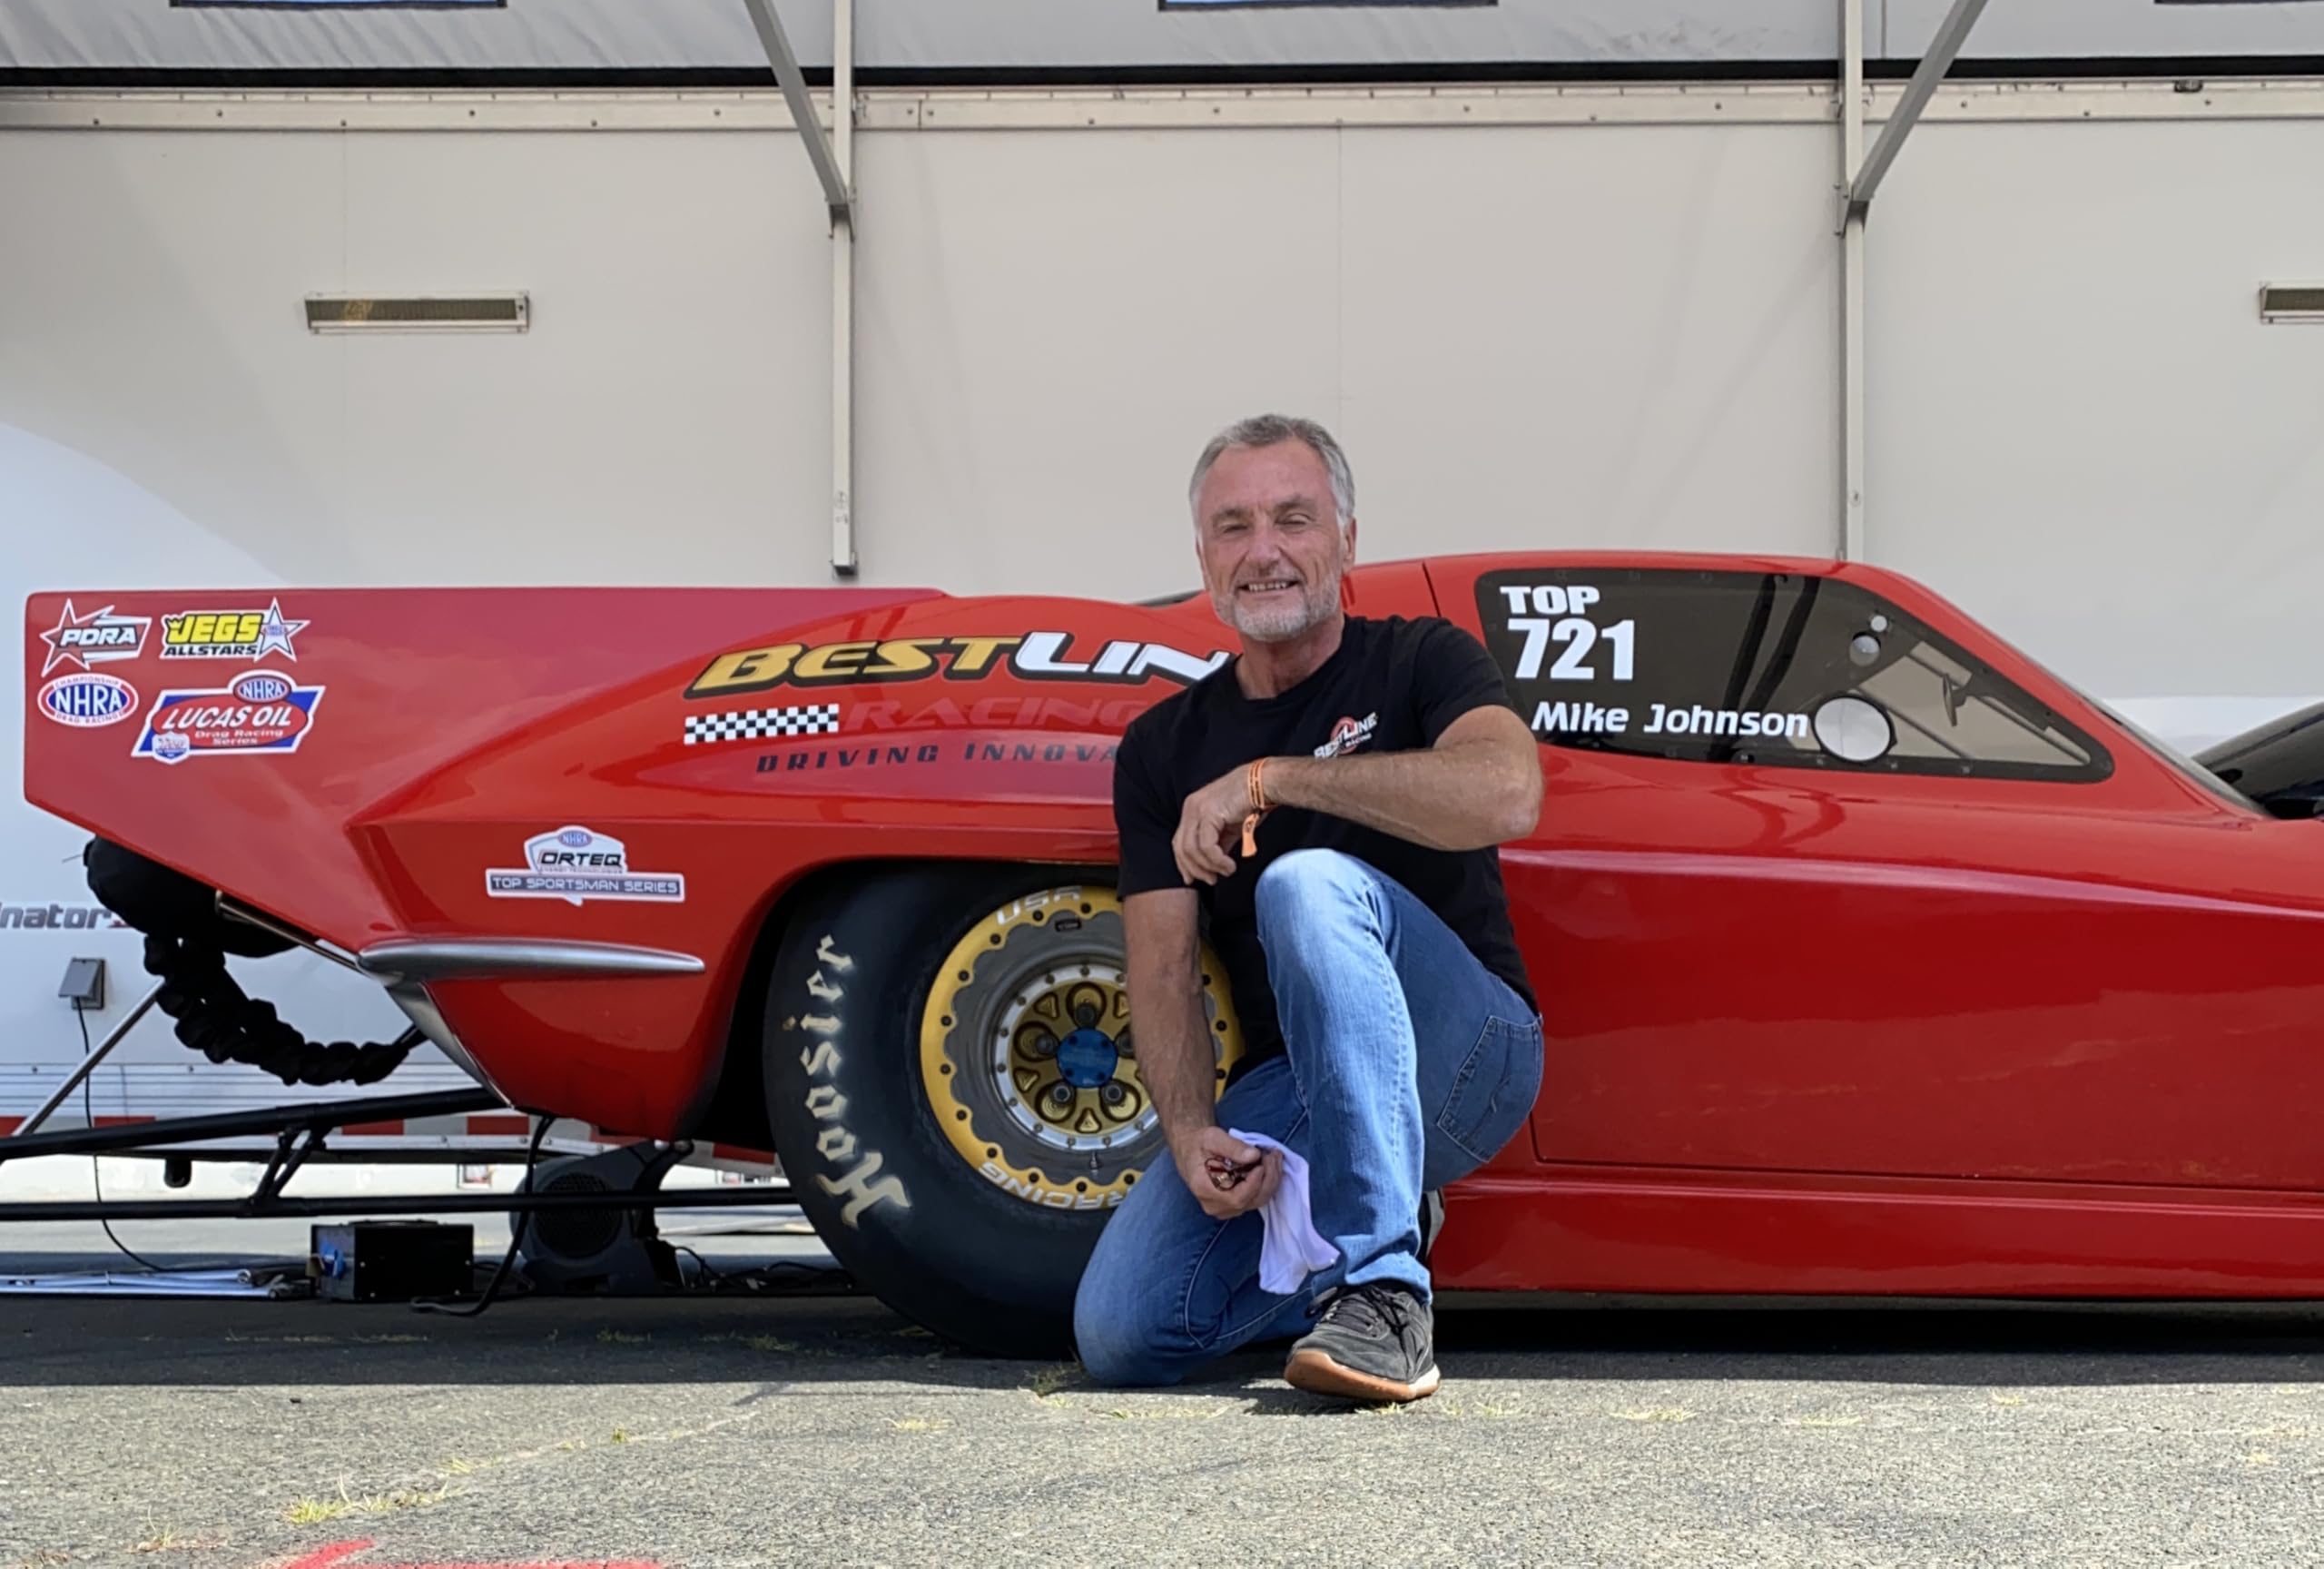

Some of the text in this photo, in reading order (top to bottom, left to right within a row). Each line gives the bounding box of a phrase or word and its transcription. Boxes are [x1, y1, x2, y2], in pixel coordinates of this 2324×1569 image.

[1500, 586, 1600, 615] TOP
[59, 627, 137, 646] PDRA
[167, 614, 263, 644] JEGS
[163, 645, 257, 656] ALLSTARS
[1507, 618, 1634, 681] 721
[54, 684, 123, 715] NHRA
[239, 680, 284, 699] NHRA
[55, 712, 81, 724] DRAG
[162, 706, 292, 730] LUCAS OIL
[843, 696, 1149, 730] RACING
[1531, 702, 1808, 737] Mike Johnson
[194, 728, 284, 740] Drag Racing
[212, 737, 258, 746] Series
[756, 745, 938, 773] DRIVING
[493, 877, 677, 893] TOP SPORTSMAN SERIES
[0, 902, 112, 929] nator
[783, 933, 912, 1231] Hoosier
